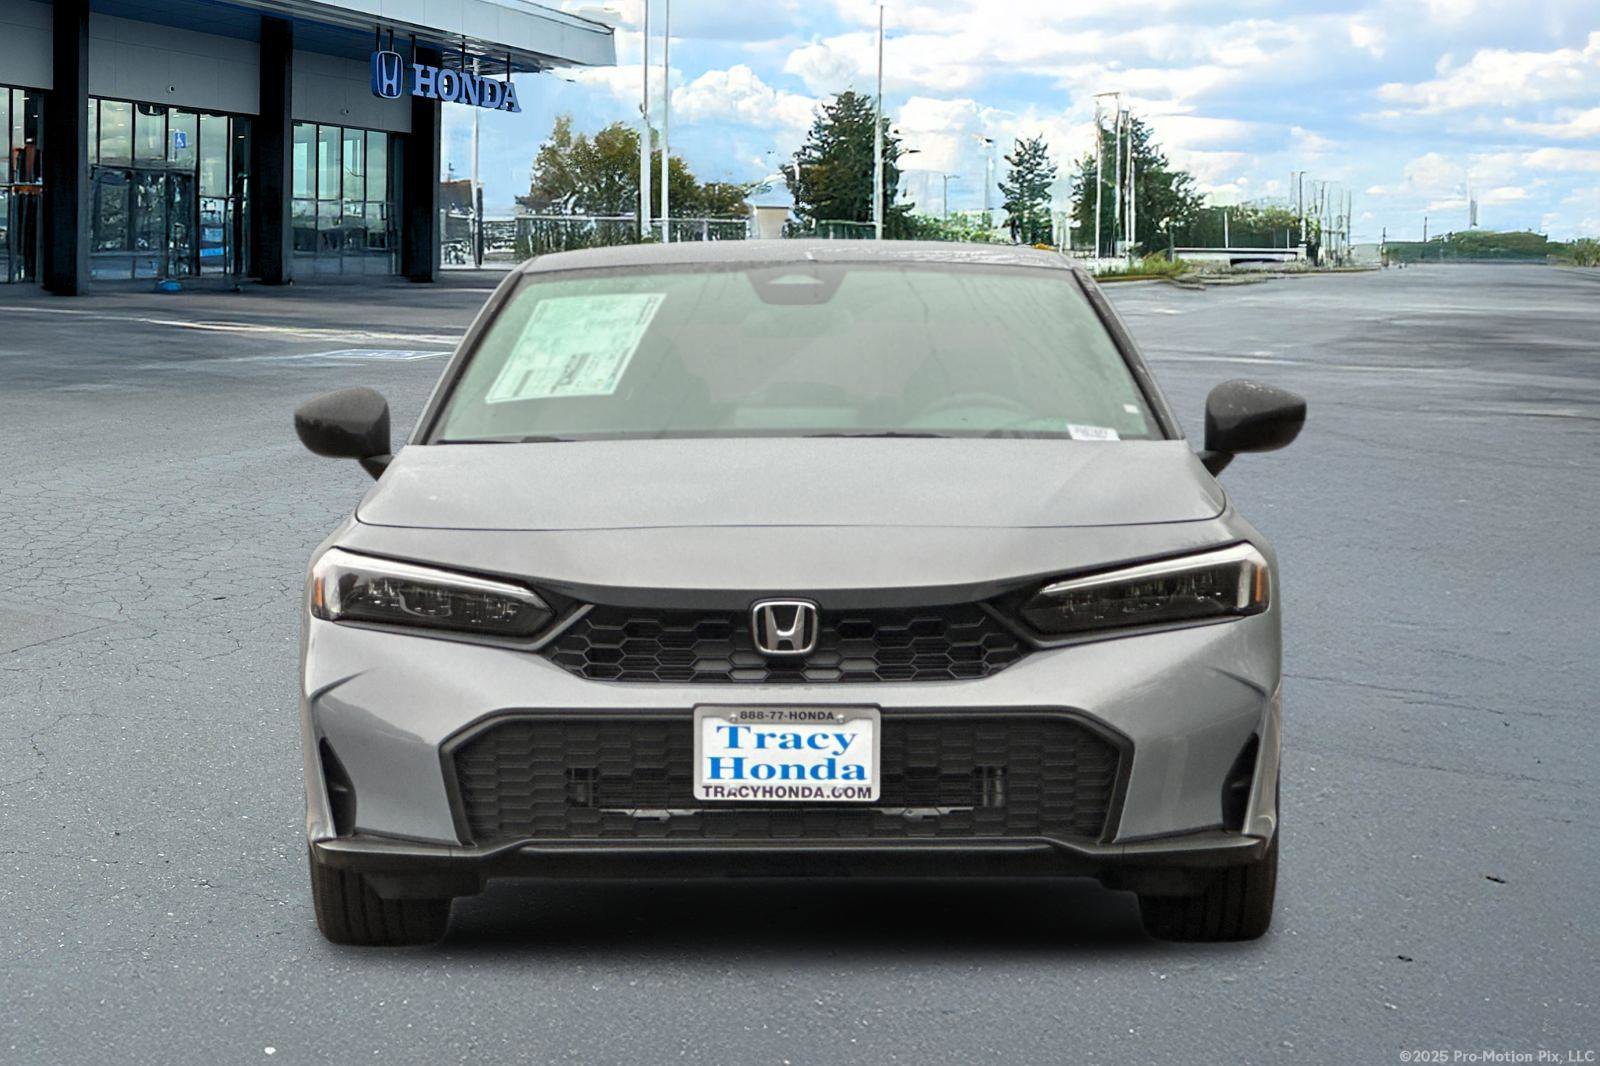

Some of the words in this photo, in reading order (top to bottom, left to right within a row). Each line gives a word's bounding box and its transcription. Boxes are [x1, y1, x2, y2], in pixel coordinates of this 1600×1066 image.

[412, 63, 522, 112] HONDA
[740, 711, 834, 720] 888-77-HONDA
[716, 726, 857, 756] Tracy
[706, 757, 866, 780] Honda
[702, 785, 872, 799] TRACYHONDA.COM
